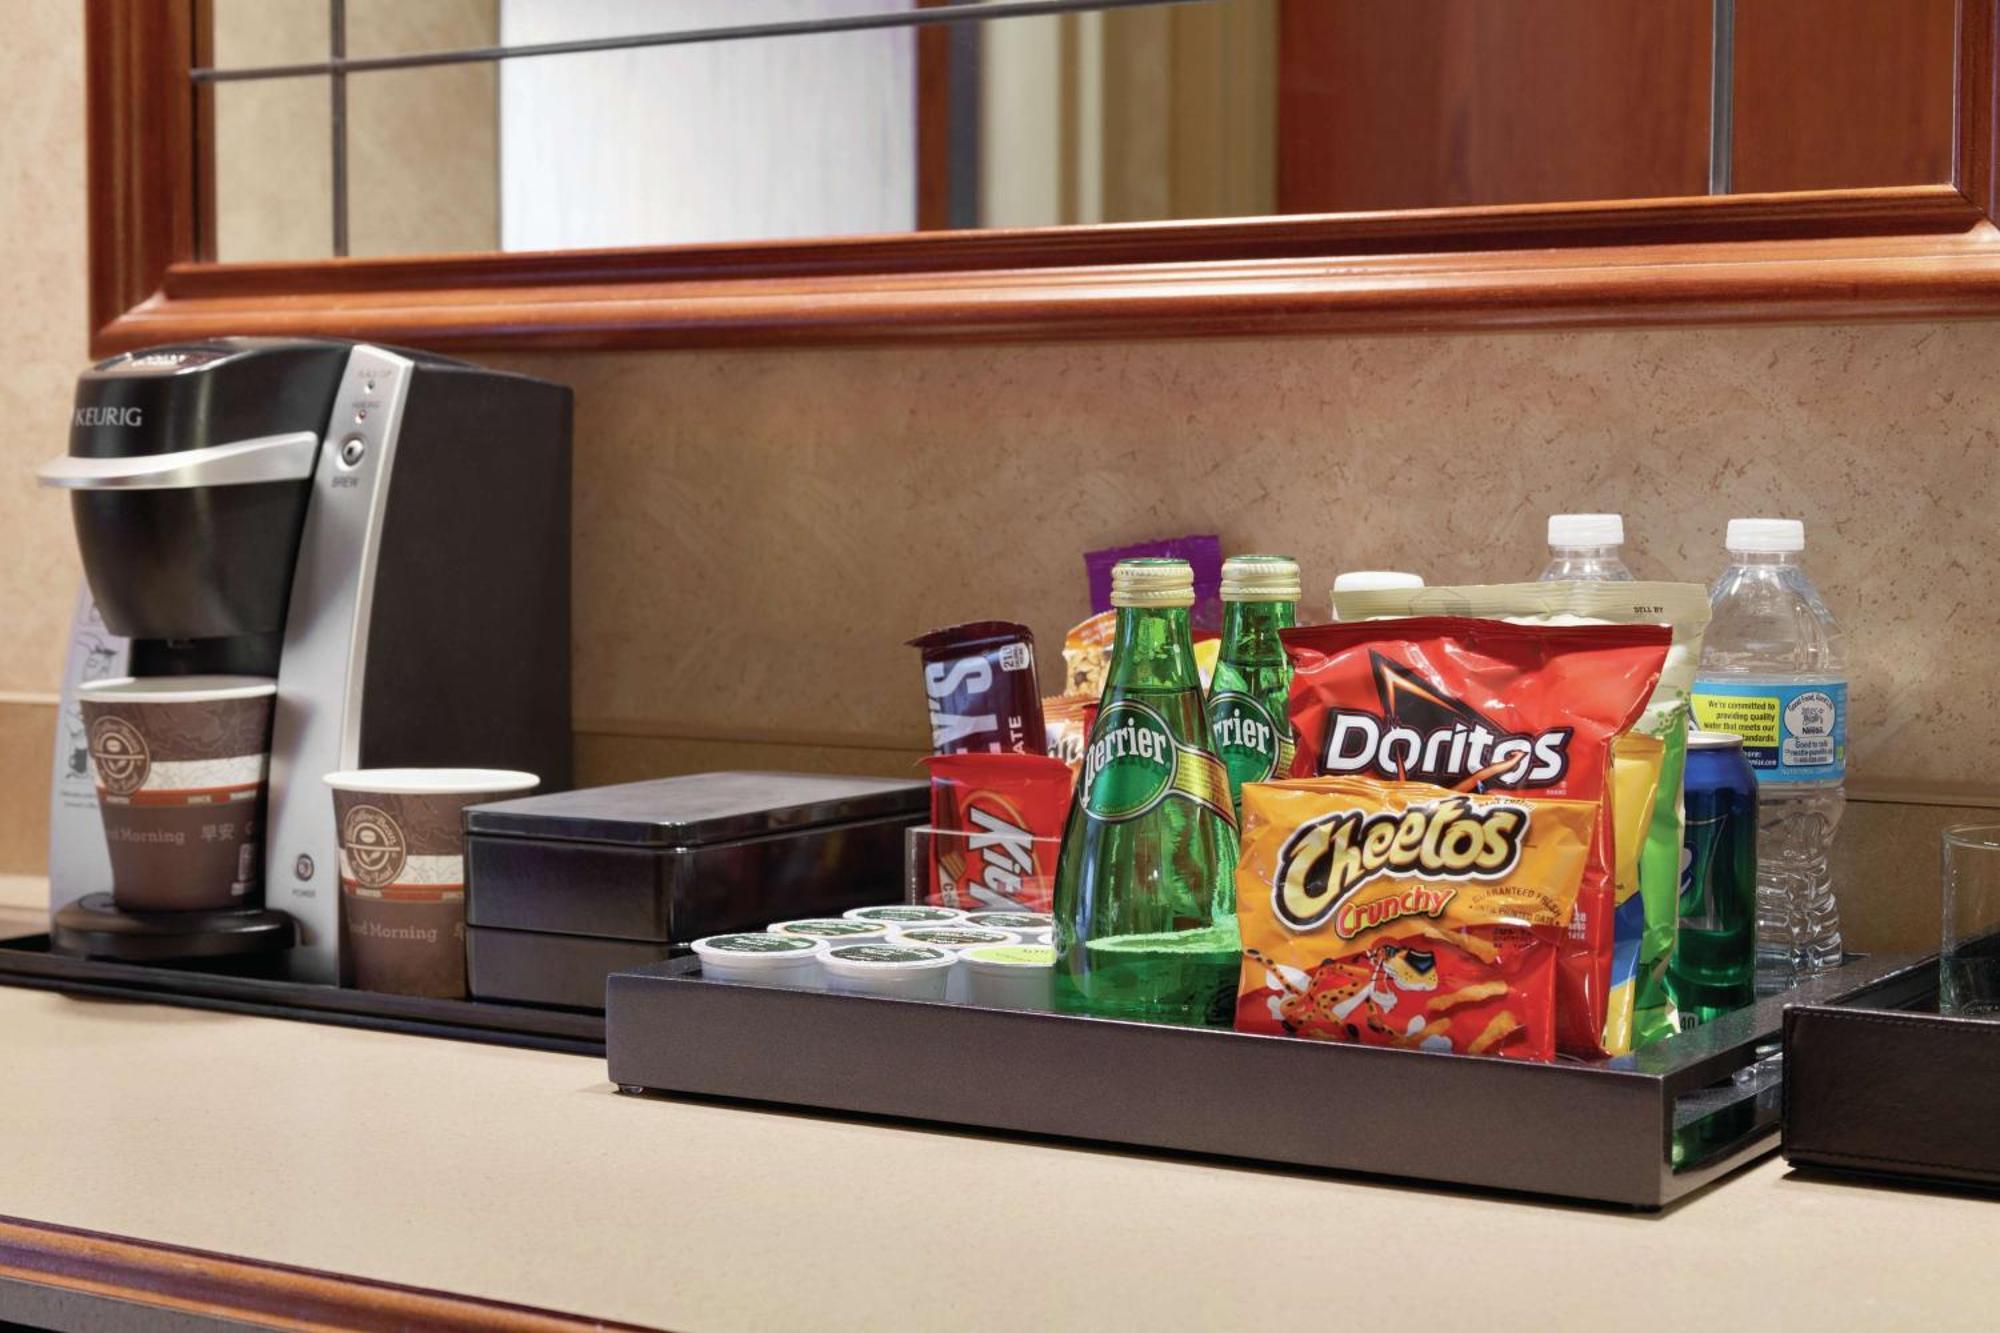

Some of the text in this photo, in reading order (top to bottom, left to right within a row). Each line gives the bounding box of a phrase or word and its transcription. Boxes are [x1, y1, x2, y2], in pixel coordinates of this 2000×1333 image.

[75, 406, 143, 428] KEURIG
[925, 656, 1000, 755] Y'S
[1708, 700, 1776, 710] We're committed to
[1704, 722, 1721, 730] water
[1724, 722, 1737, 730] that
[1738, 723, 1761, 731] meets
[1716, 712, 1775, 722] providing quality
[1008, 715, 1026, 755] ATE
[1213, 708, 1270, 755] rrier
[1742, 734, 1776, 742] tandards.
[1323, 712, 1568, 786] Doritos
[120, 828, 185, 845] Morning
[1277, 797, 1525, 925] Cheetos
[1335, 884, 1458, 940] Crunchy
[369, 922, 438, 943] Morning
[1680, 1015, 1696, 1031] 40
